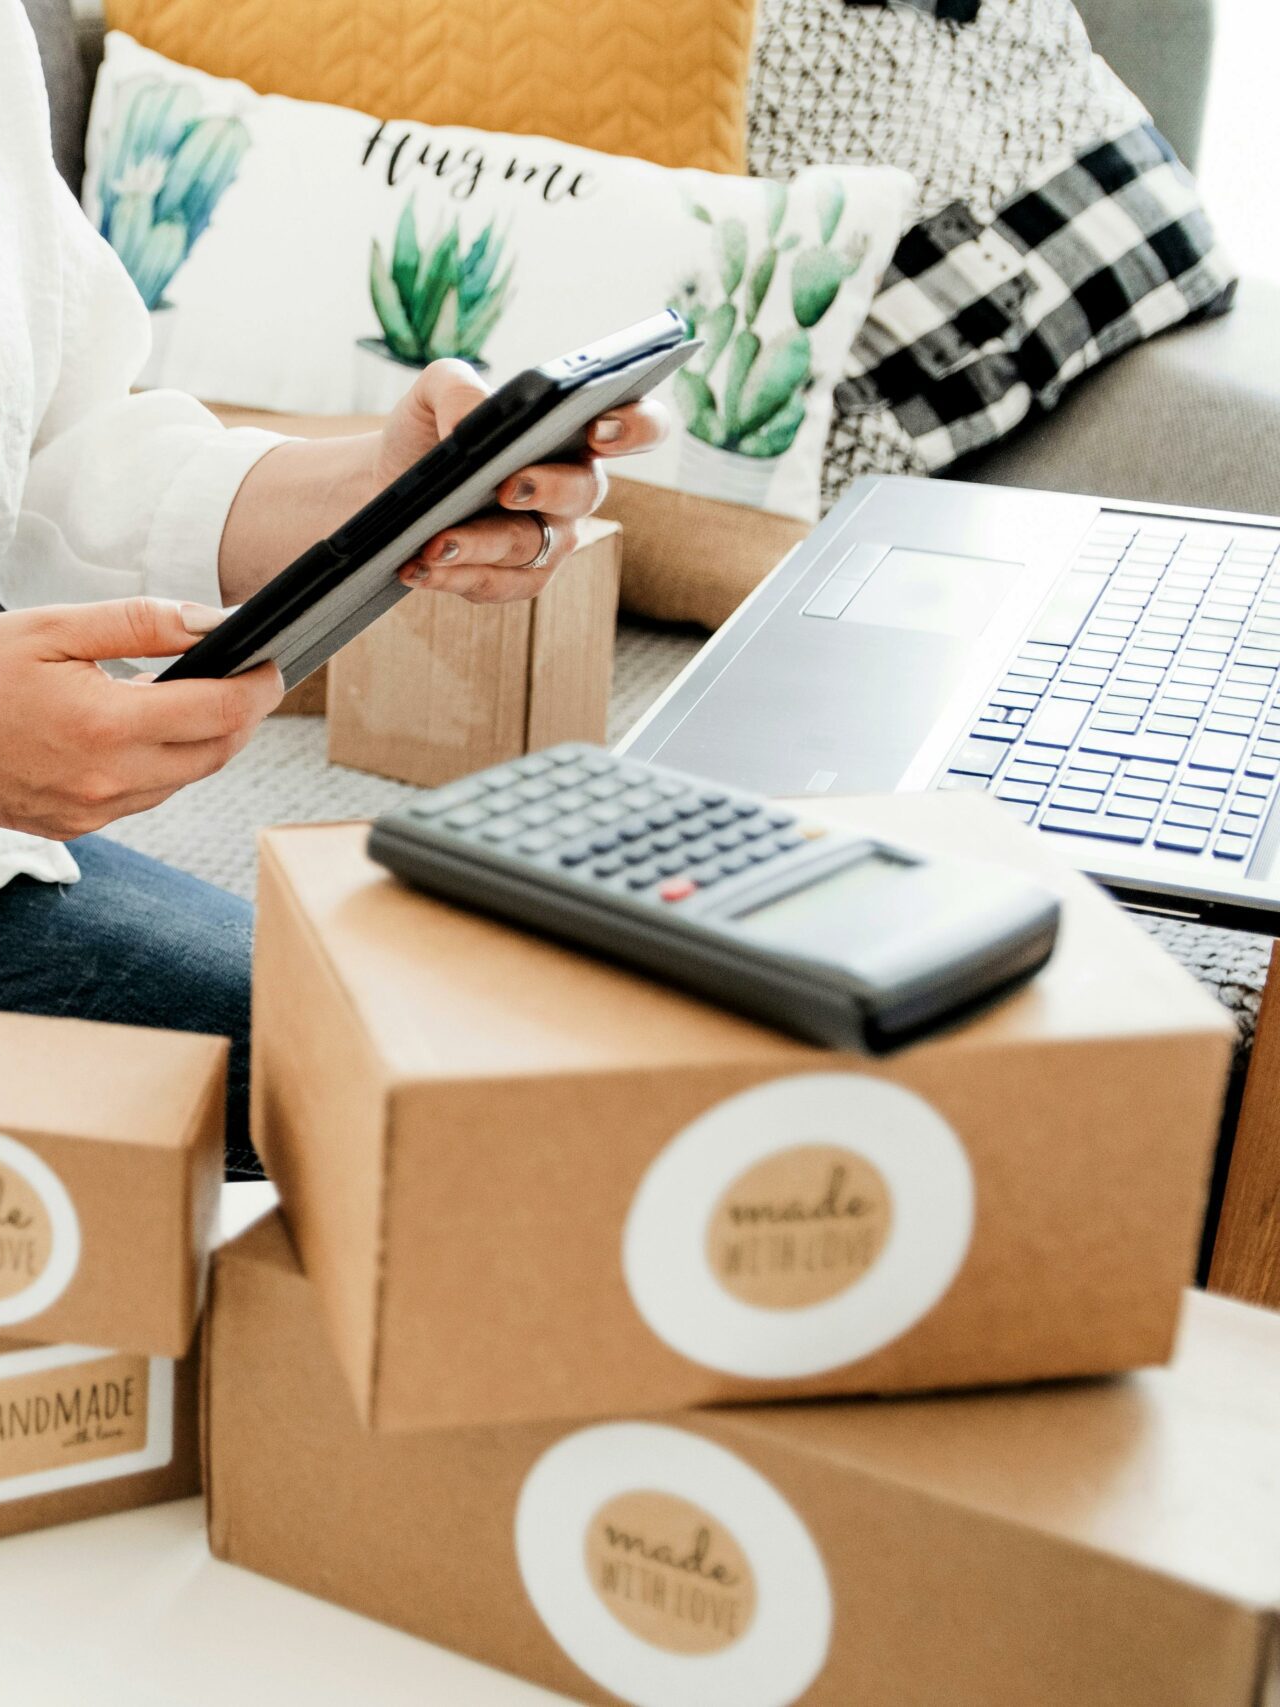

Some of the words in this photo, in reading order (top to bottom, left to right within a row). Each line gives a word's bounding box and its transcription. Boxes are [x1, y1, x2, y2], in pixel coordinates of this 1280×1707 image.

[361, 120, 486, 200] Hug
[503, 157, 595, 203] me
[728, 1164, 872, 1227] made
[606, 1524, 740, 1587] made
